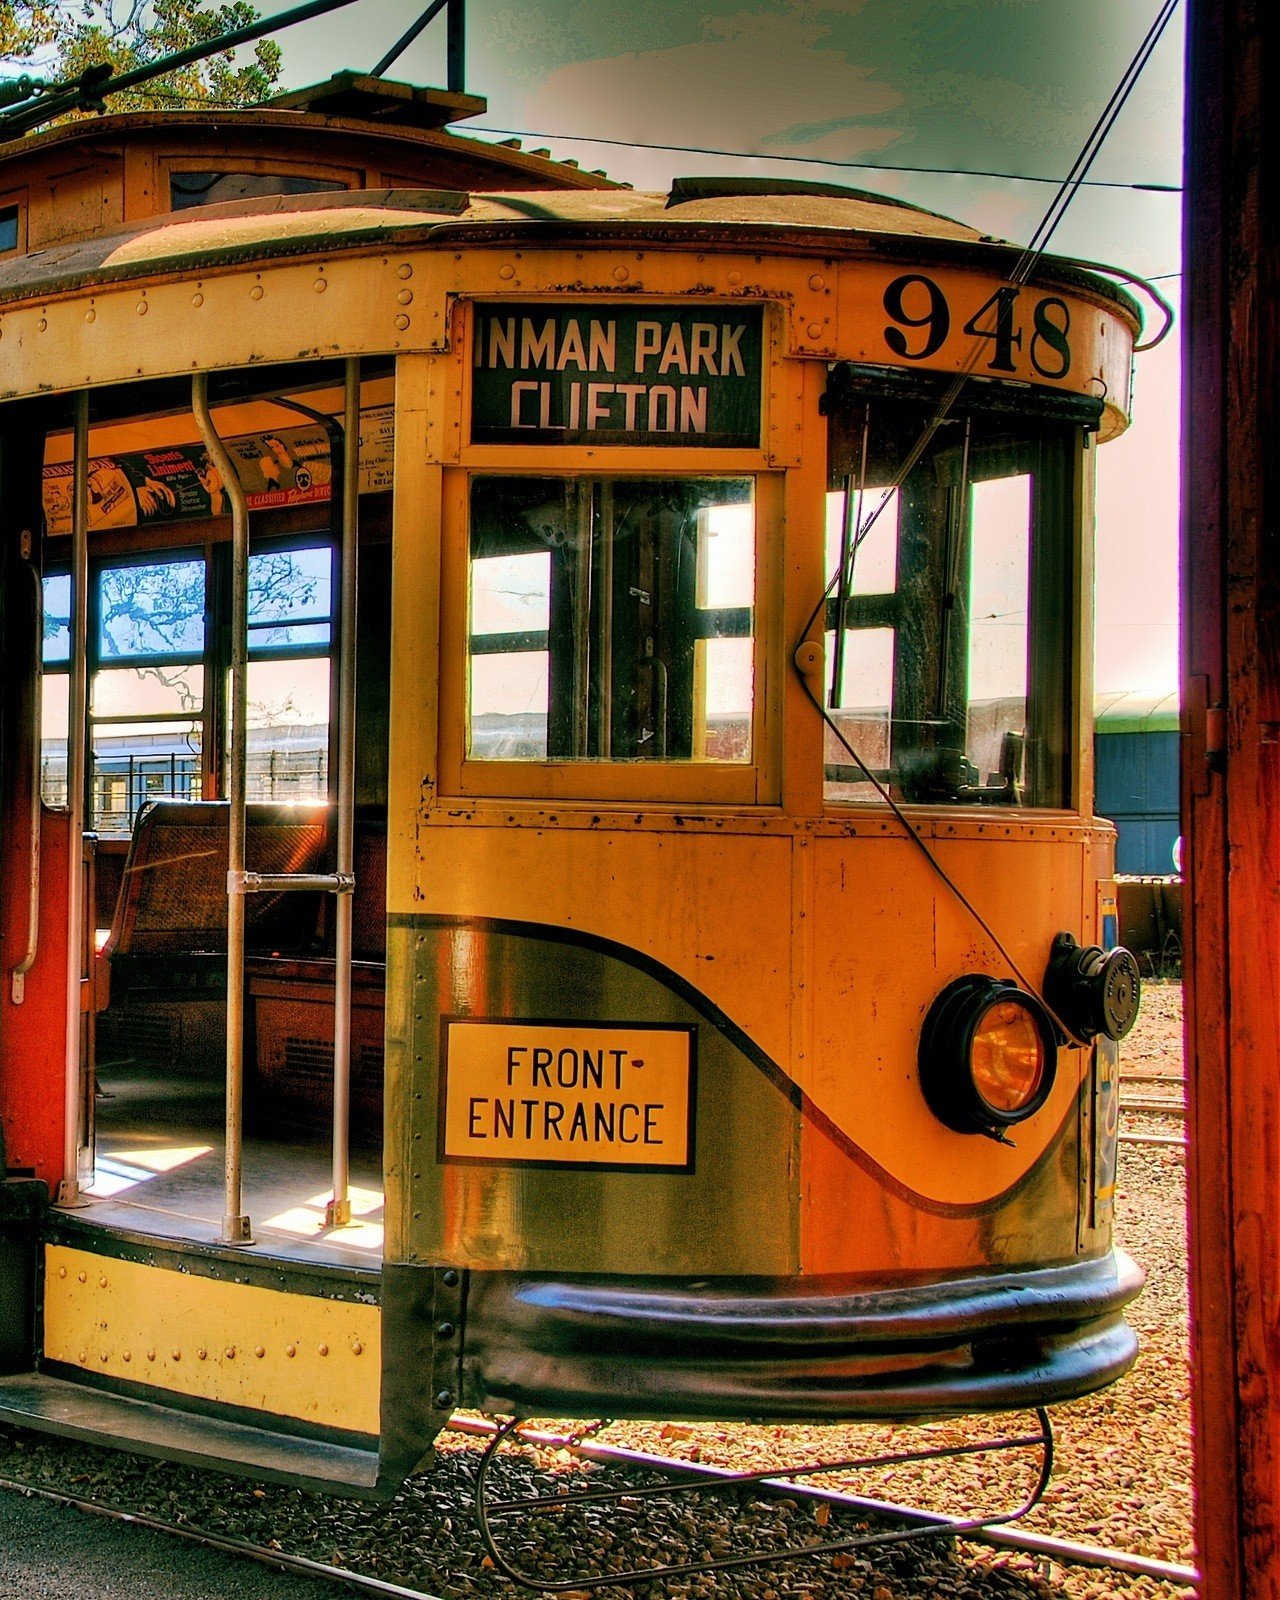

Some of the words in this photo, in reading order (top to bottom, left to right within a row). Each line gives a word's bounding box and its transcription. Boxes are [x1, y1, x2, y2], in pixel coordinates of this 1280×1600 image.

[475, 318, 616, 372] INMAN
[634, 320, 747, 376] PARK
[883, 274, 1070, 379] 948
[510, 381, 708, 433] CLIFTON
[147, 459, 196, 477] Liniment
[254, 492, 286, 505] CLASSIFIED
[507, 1046, 628, 1089] FRONT
[468, 1097, 665, 1144] ENTRANCE
